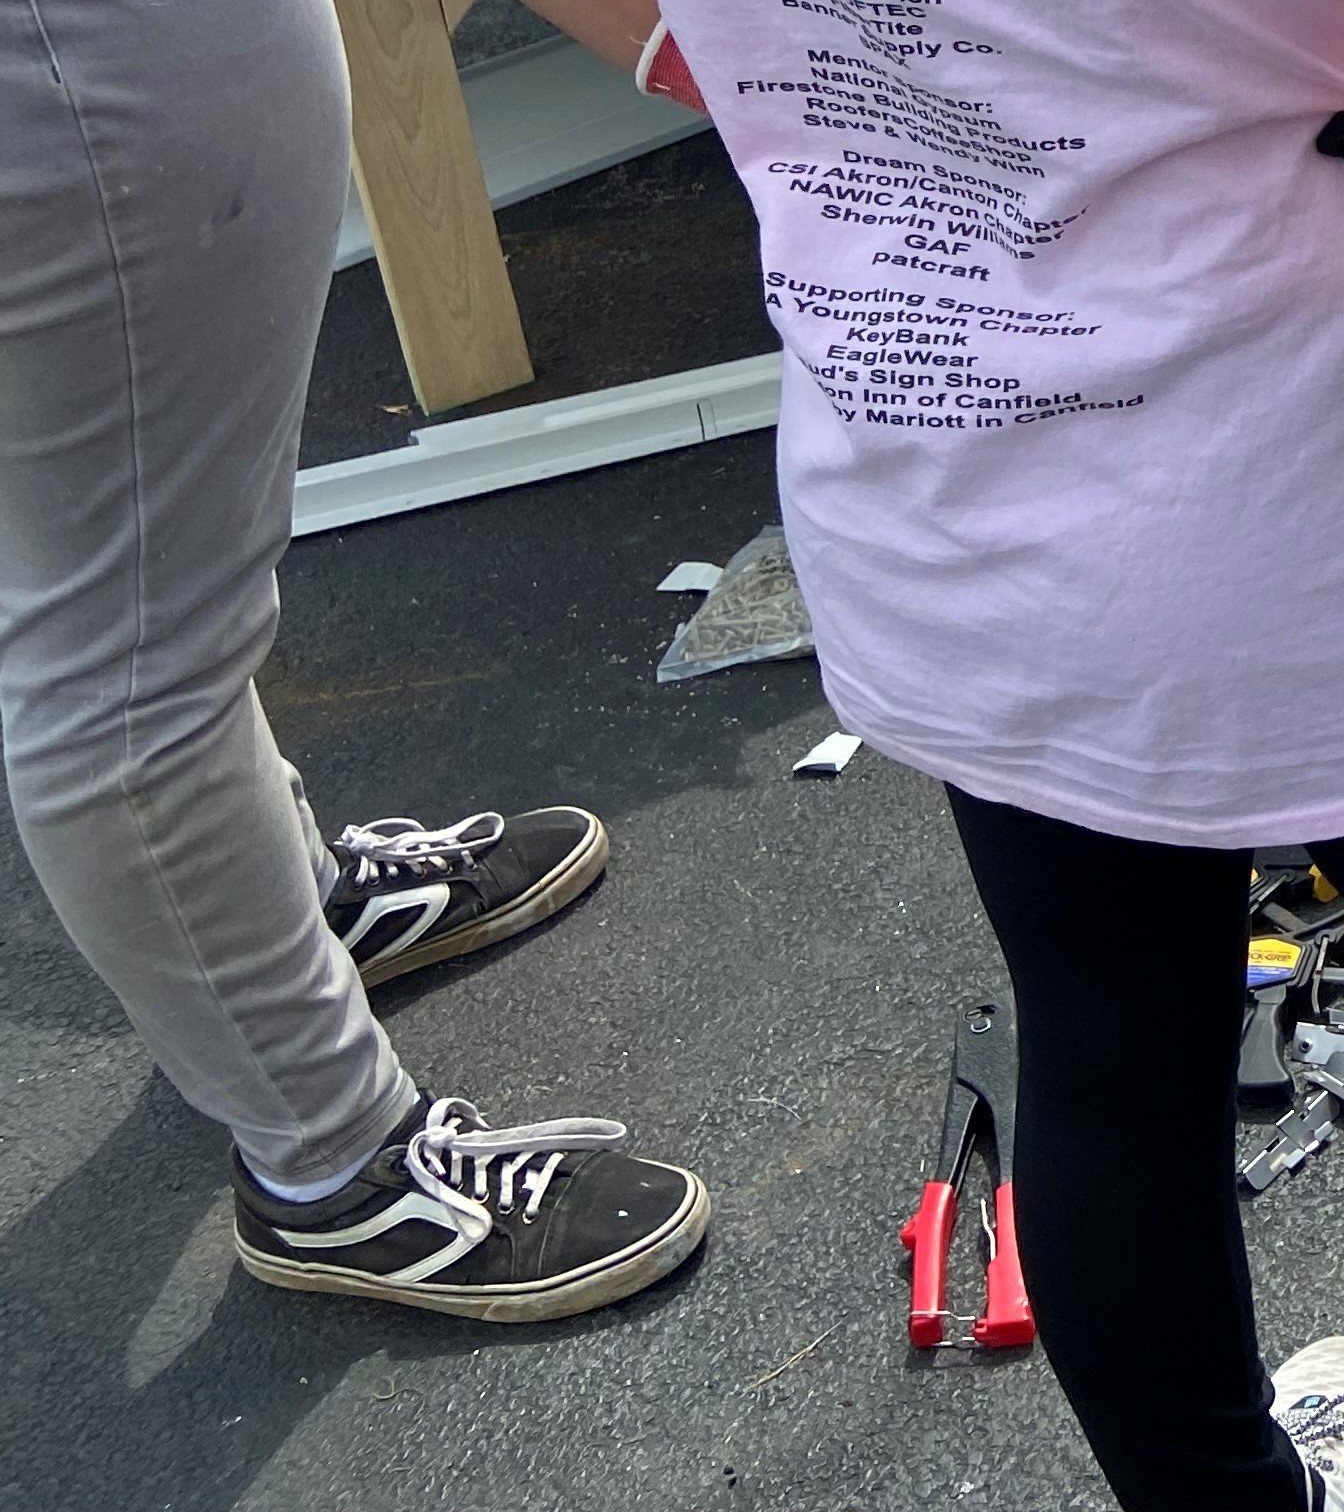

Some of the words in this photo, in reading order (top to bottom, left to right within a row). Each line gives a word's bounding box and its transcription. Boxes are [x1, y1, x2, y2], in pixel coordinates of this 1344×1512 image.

[807, 48, 888, 78] Mentor
[952, 40, 1002, 56] Co.
[809, 66, 909, 98] National
[737, 80, 866, 103] Firestone
[873, 93, 961, 138] Building
[966, 126, 1086, 152] Products
[802, 113, 877, 135] Steve
[884, 125, 901, 139] &
[905, 129, 980, 164] Wendy
[984, 156, 1046, 179] Winn
[768, 162, 818, 176] CSI
[822, 165, 999, 211] Akron/Canton
[842, 149, 926, 174] Dream
[933, 165, 1028, 207] Sponsor:
[789, 178, 894, 207] NAWIC
[898, 194, 979, 219] Akron
[984, 212, 1065, 247] Chapter
[821, 203, 936, 232] Sherwin
[947, 220, 1036, 261] Williams
[904, 233, 972, 257] GAF
[872, 250, 991, 283] patcraft
[765, 270, 926, 308] Supporting
[935, 295, 1077, 323] Sponsor:
[764, 292, 783, 310] A
[793, 296, 970, 329] Youngstown
[979, 319, 1103, 337] Chapter
[846, 327, 972, 348] KeyBank
[827, 344, 979, 368] EagleWear
[803, 359, 859, 384] ud's
[869, 368, 935, 388] Sign
[944, 371, 1022, 394] Shop
[863, 388, 907, 407] Inn
[917, 389, 946, 408] of
[955, 392, 1083, 411] Canfield
[866, 408, 968, 430] Mariott
[975, 414, 1003, 429] in
[1014, 394, 1145, 425] Canfield
